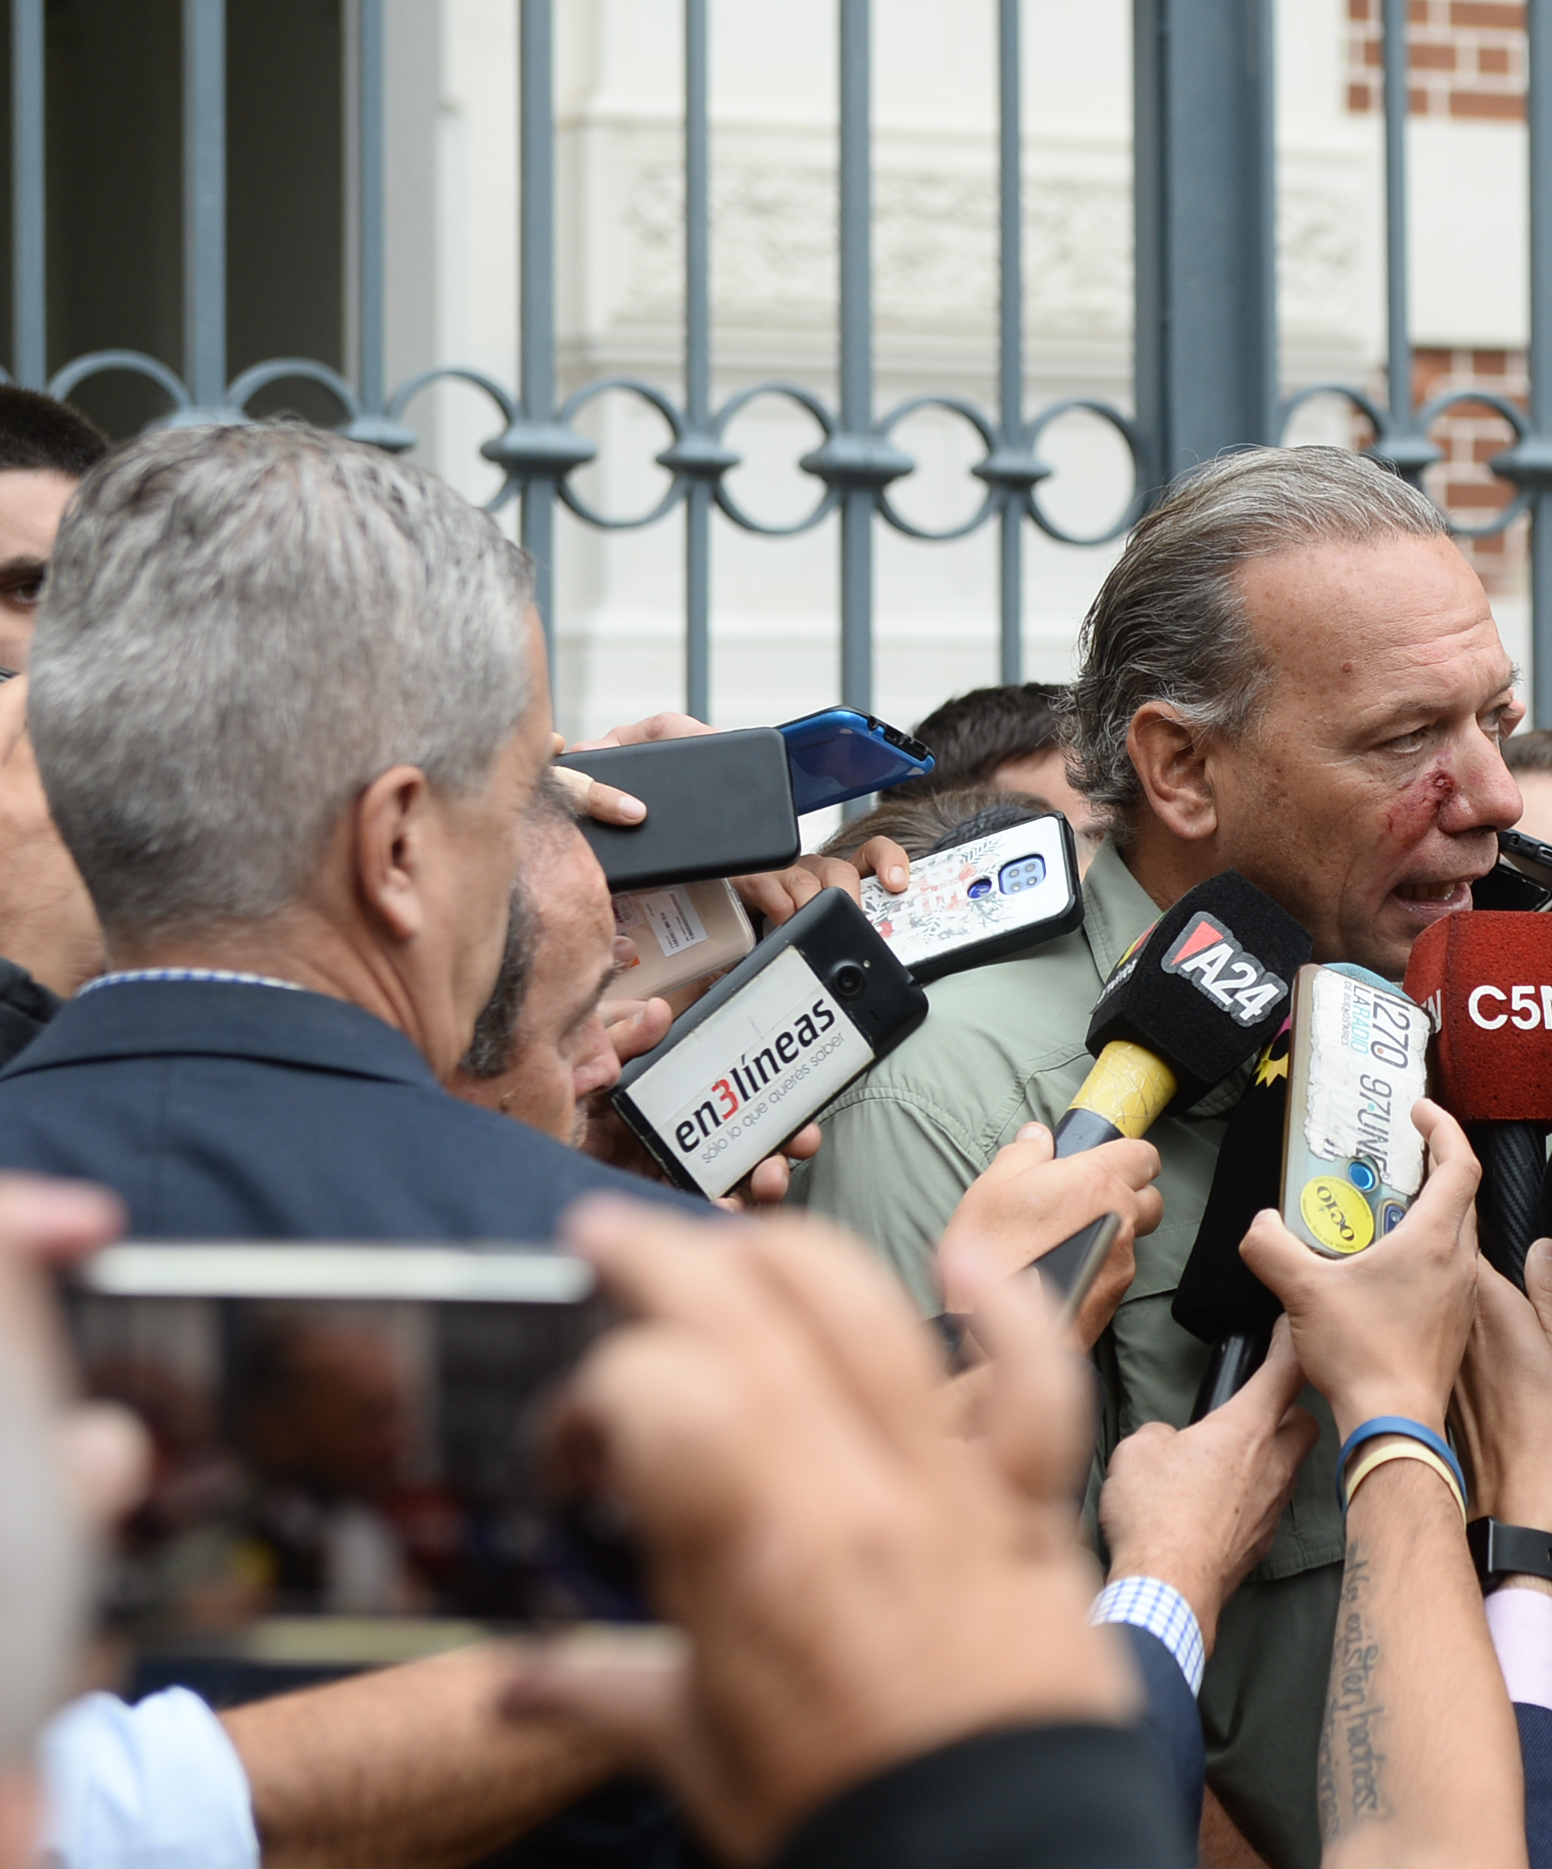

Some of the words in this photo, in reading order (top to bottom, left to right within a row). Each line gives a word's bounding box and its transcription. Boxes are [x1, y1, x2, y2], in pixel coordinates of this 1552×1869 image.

[1181, 943, 1279, 1021] A24
[1370, 993, 1411, 1069] 1270
[675, 998, 835, 1153] en3líneas
[702, 1137, 728, 1164] sólo
[726, 1125, 742, 1139] lo
[742, 1101, 768, 1128] que
[768, 1063, 811, 1103] querés
[810, 1032, 845, 1067] saber
